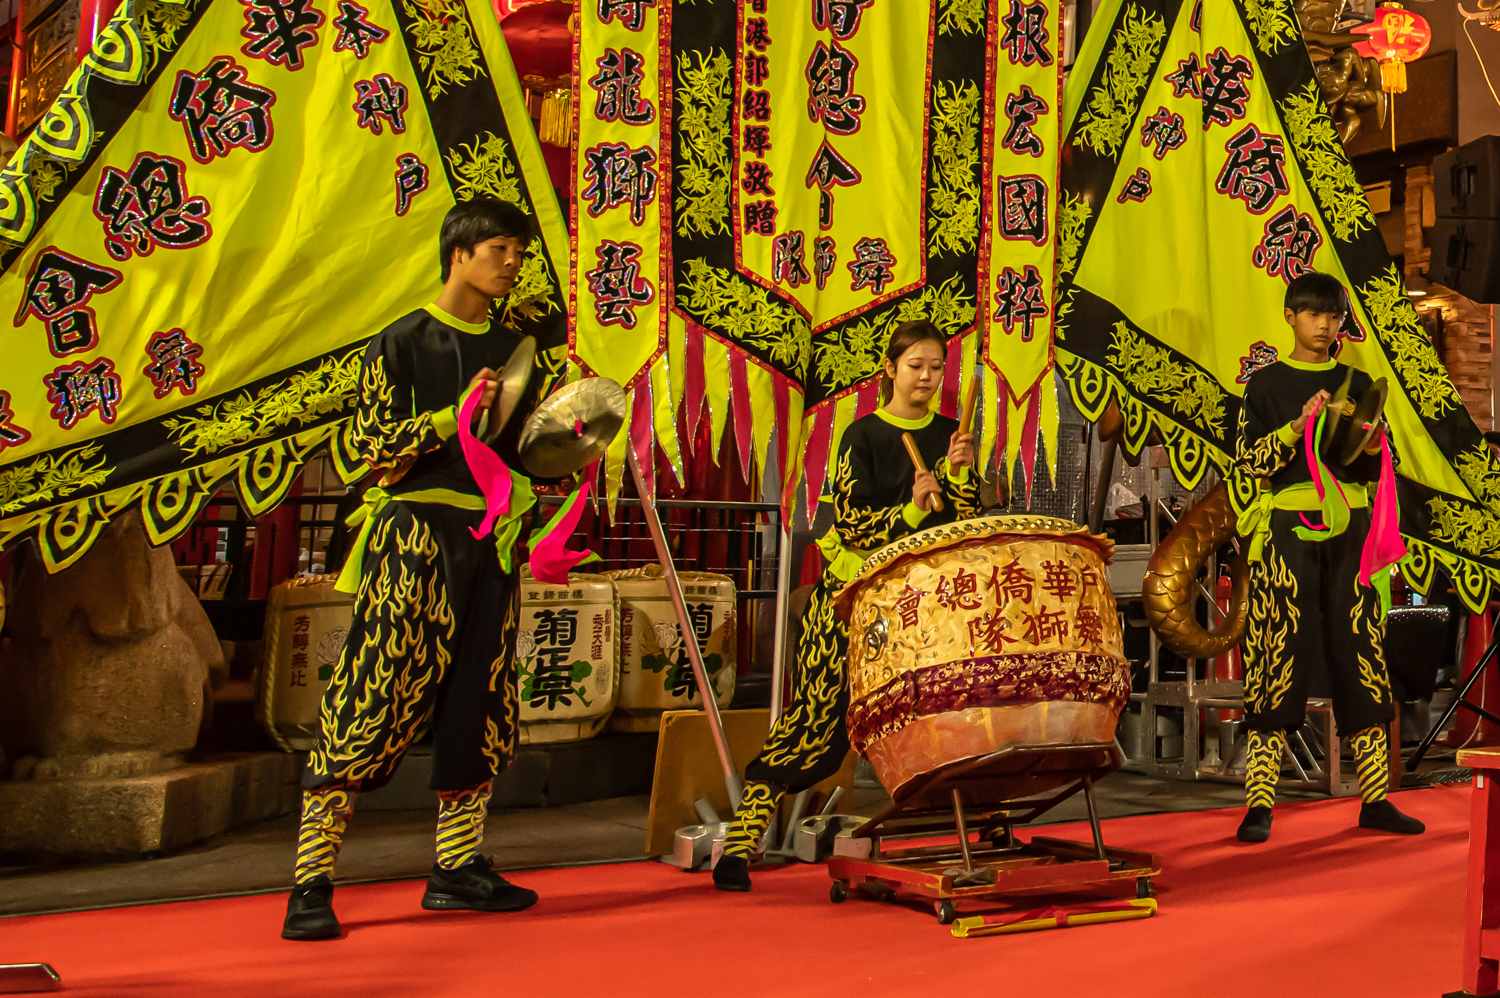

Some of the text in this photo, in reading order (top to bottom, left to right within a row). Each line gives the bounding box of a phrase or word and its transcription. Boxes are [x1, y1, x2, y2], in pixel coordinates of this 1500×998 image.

[1202, 46, 1367, 360] 華僑總
[290, 615, 311, 688] 芳醇無比
[530, 608, 579, 711] 菊正宗
[967, 602, 1104, 658] 舞獅隊
